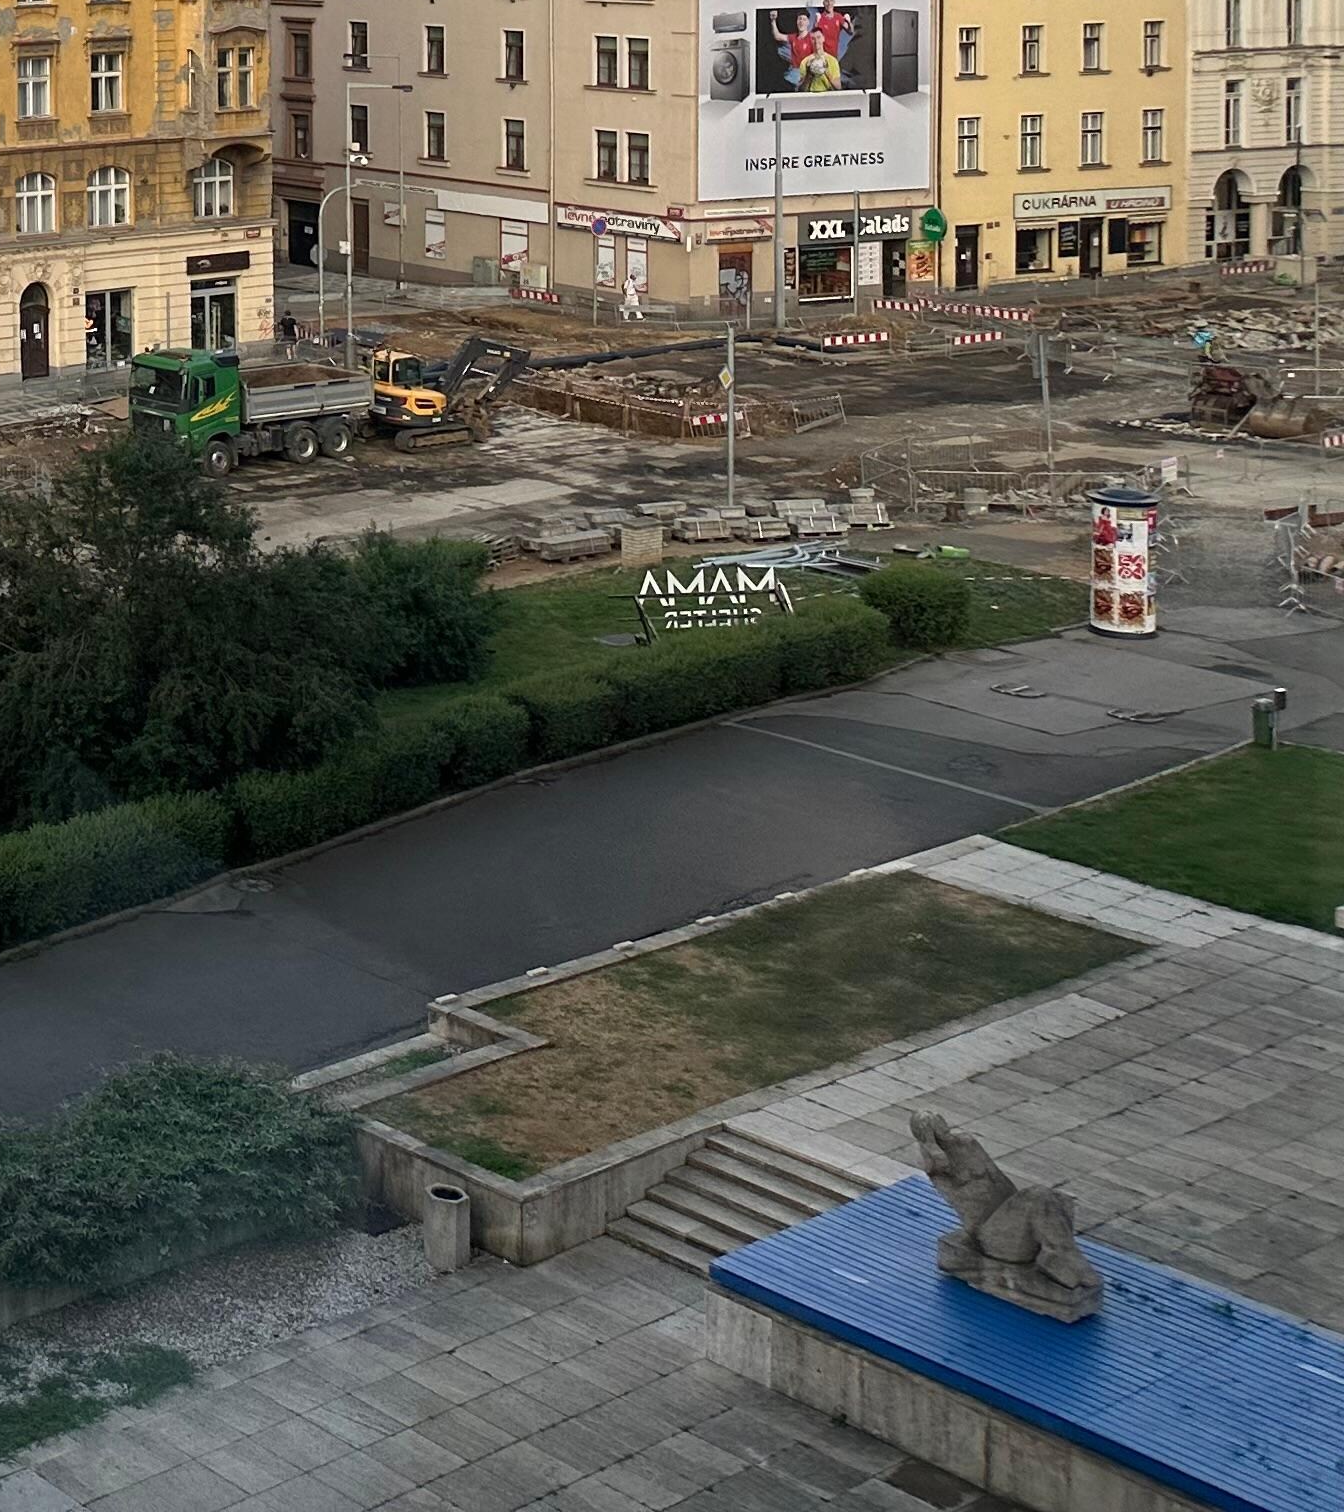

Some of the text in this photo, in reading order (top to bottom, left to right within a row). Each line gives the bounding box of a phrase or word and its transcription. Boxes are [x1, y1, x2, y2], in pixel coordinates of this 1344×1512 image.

[745, 152, 884, 171] INSPRE GREATNESS
[1022, 195, 1097, 210] CUKRÁRNA
[809, 219, 845, 240] XXL
